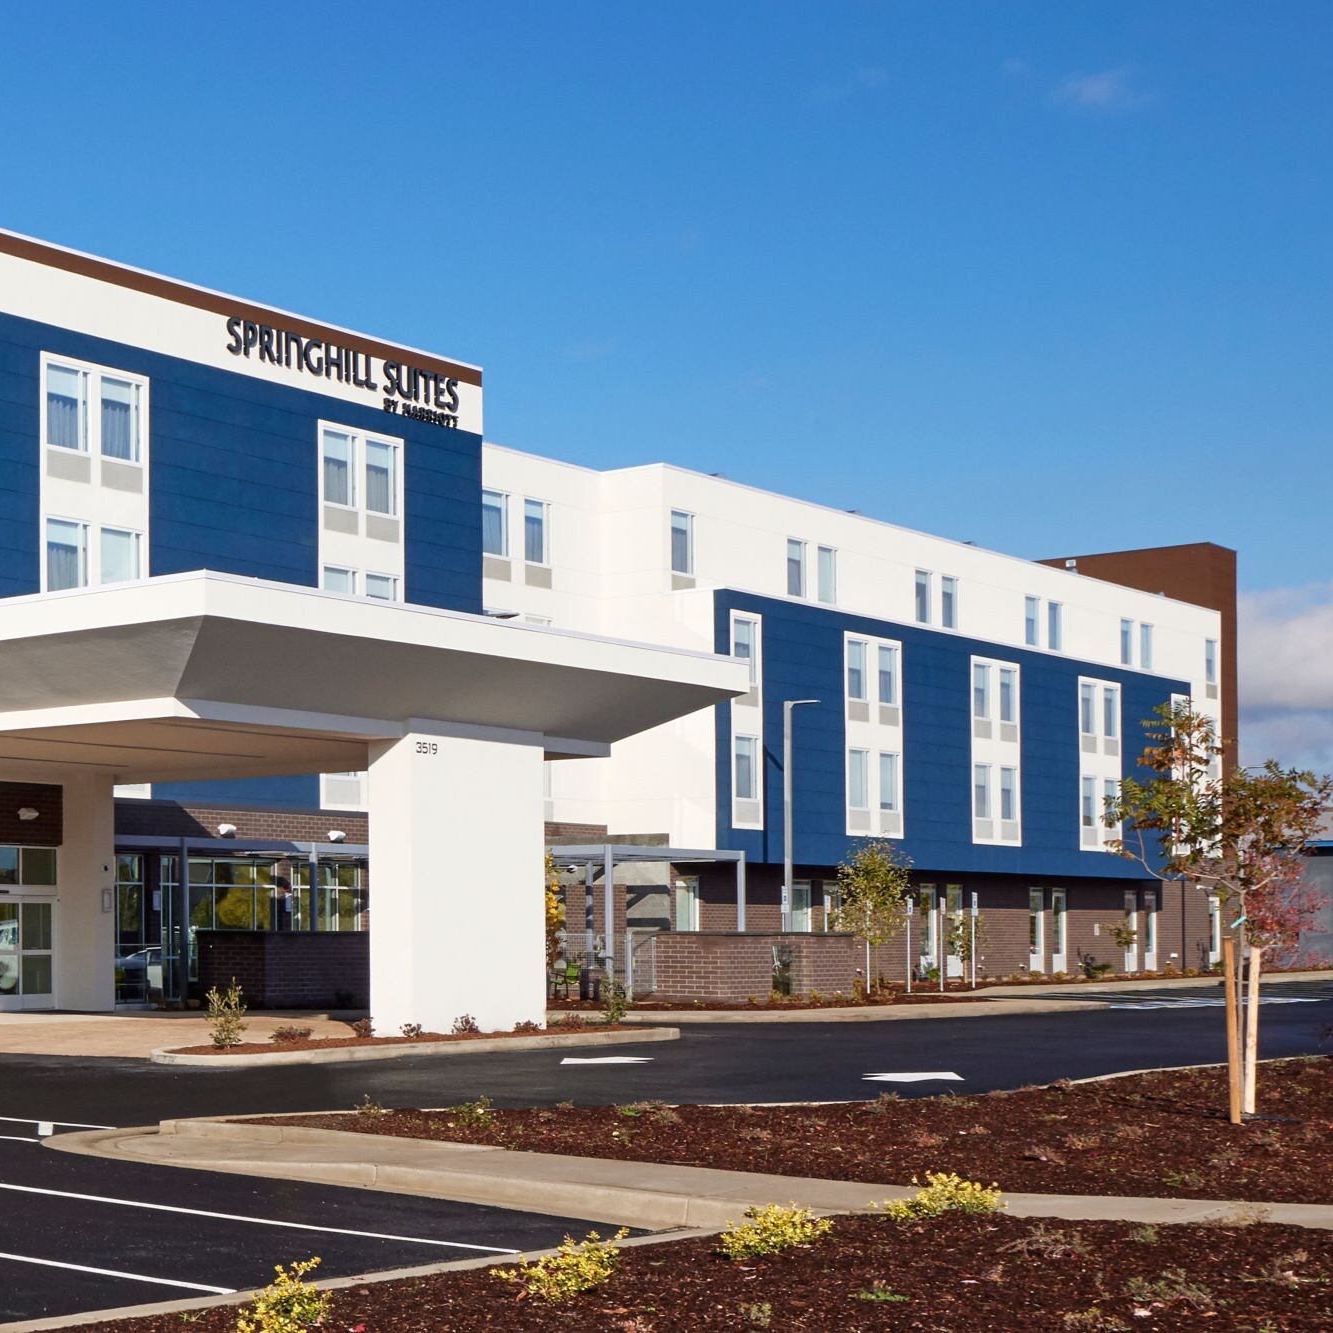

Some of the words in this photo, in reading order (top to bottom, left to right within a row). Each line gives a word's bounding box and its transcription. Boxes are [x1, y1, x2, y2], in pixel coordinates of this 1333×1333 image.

[226, 316, 378, 392] SPRINGHILL
[383, 360, 459, 413] SUITES
[383, 398, 398, 413] BY
[416, 742, 438, 755] 3519
